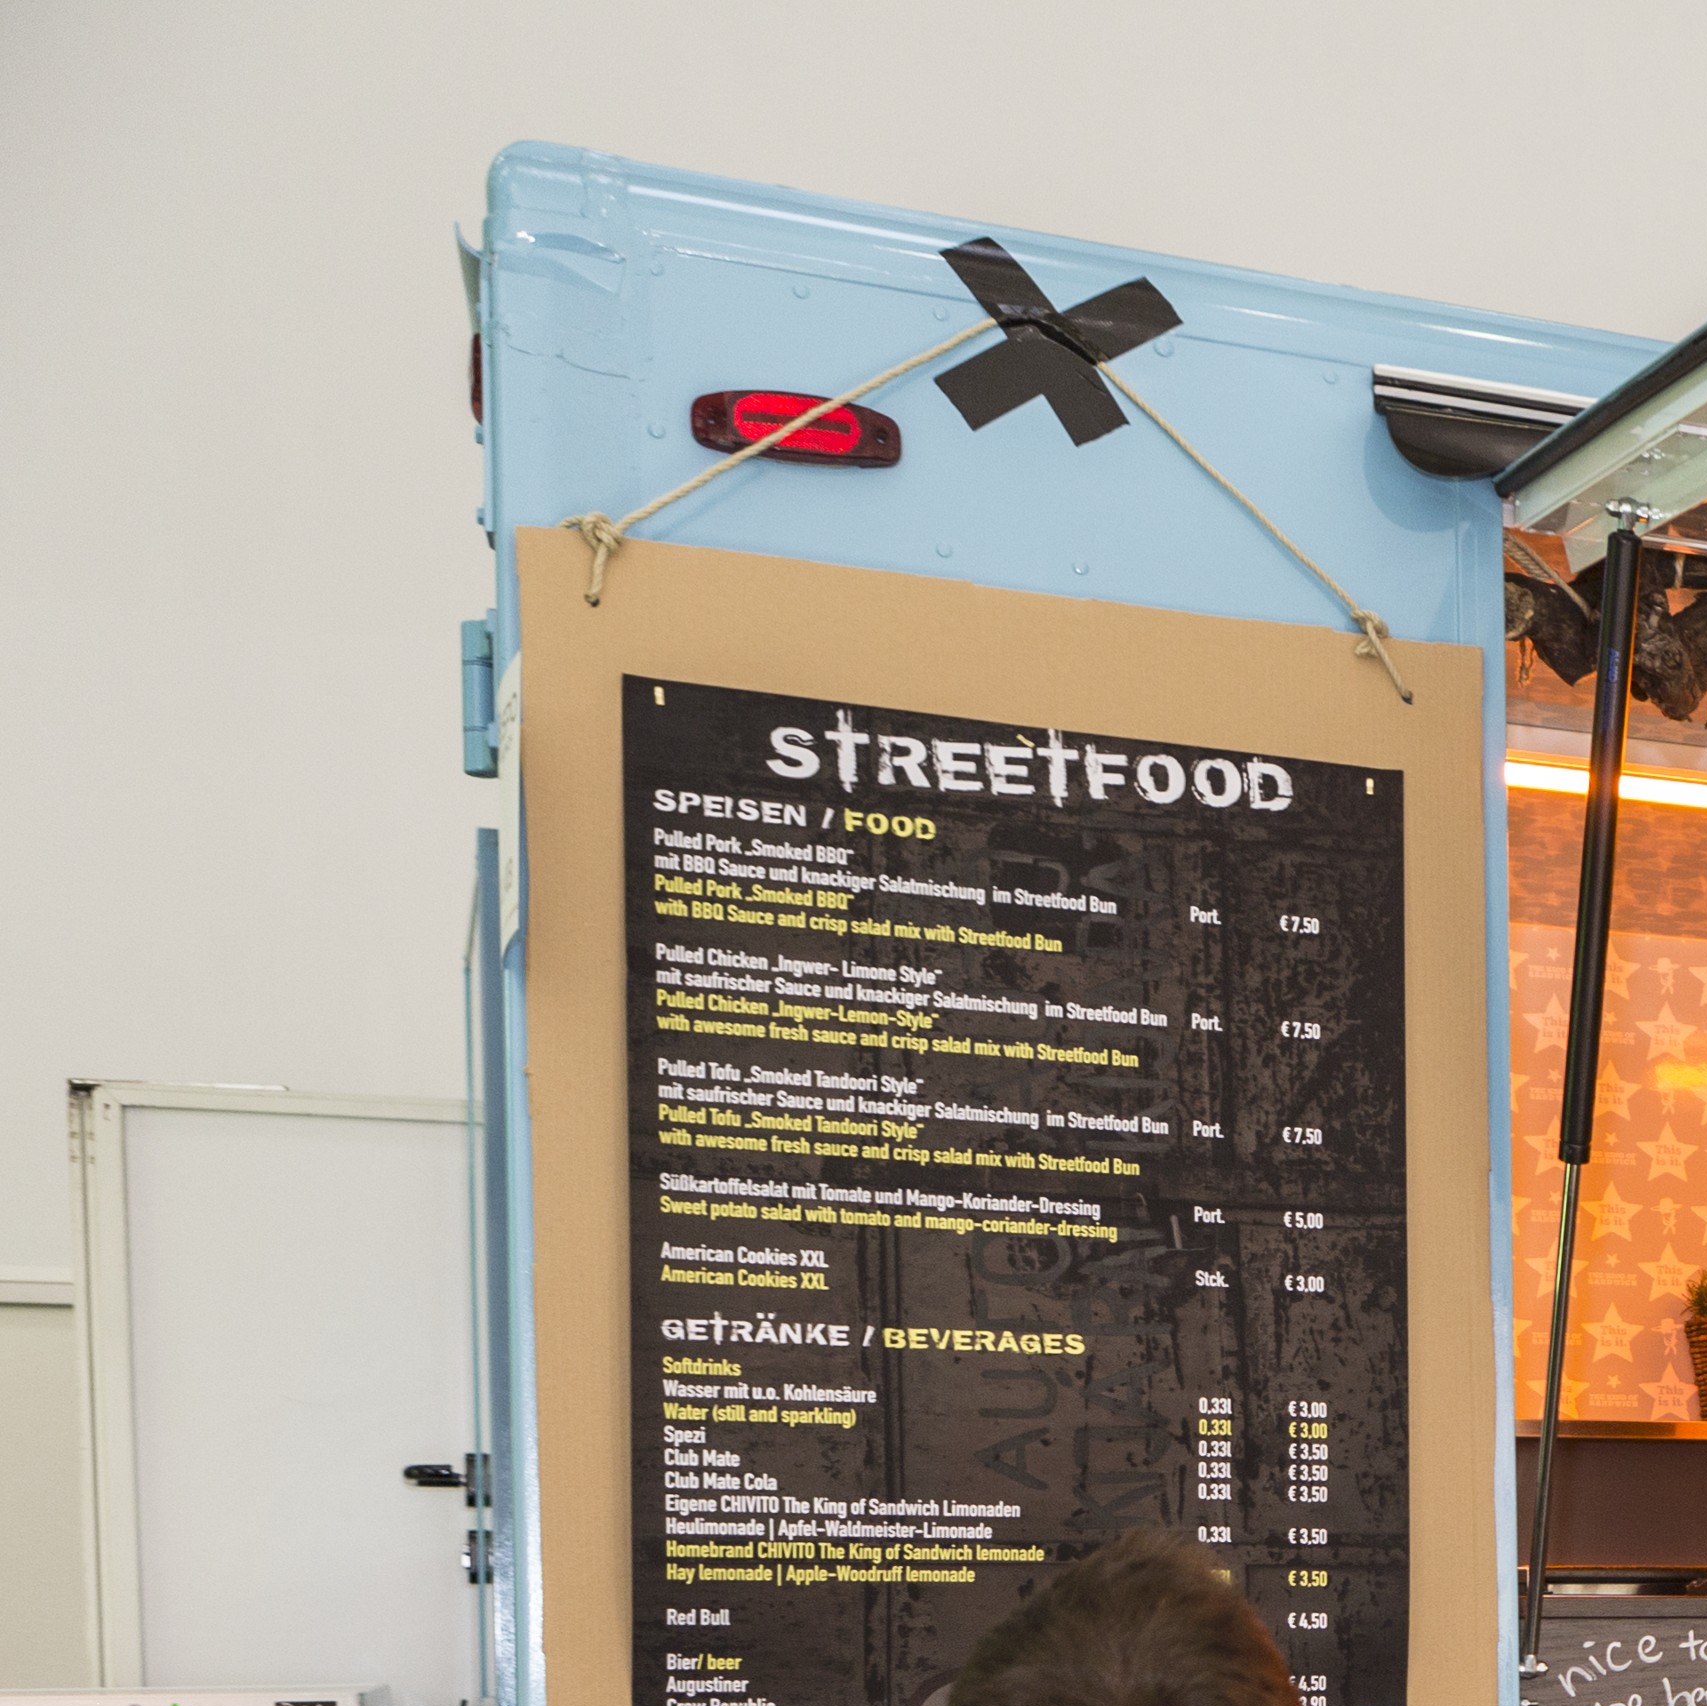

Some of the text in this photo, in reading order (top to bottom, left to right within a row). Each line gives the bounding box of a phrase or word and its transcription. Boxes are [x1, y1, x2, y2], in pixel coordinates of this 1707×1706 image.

[766, 709, 1295, 812] STREETFOOD
[653, 789, 808, 828] SPEISEN
[844, 808, 937, 841] FOOD
[654, 852, 1118, 916] mit BBQ Sauce und knackiger Salatmischung im Streetfood Bun
[1190, 906, 1223, 927] Port.
[660, 1172, 1102, 1222] Süßkartoffelsalat mit Tomate und Mango-Koriander-Dressing
[660, 1195, 1119, 1244] Sweet potato salad with tomato and mango-coriander-dressing
[660, 1241, 831, 1269] American Cookies XXL
[661, 1264, 831, 1291] American Cookies XXL
[660, 1311, 851, 1348] GETRÄNKE
[882, 1328, 1087, 1356] BEVERAGES
[662, 1356, 743, 1378] Softdrinks
[663, 1379, 722, 1400] Wasser
[723, 1382, 751, 1400] mit
[783, 1383, 878, 1404] Kohlensäure
[663, 1402, 857, 1430] Water (still and sparkling)
[664, 1425, 707, 1448] Spezi
[664, 1448, 742, 1468] Club Mate
[665, 1471, 779, 1492] Club Mate Cola
[665, 1494, 1022, 1520] Eigene CHIVITO The King of Sandwich Limonaden
[665, 1514, 766, 1537] Heulimonade
[778, 1517, 994, 1542] Apfel-Waldmeister-Limonade
[666, 1563, 697, 1586] Hay
[699, 1564, 774, 1582] lemonade
[785, 1565, 904, 1587] Apple-Woodruff
[906, 1566, 977, 1584] lemonade
[666, 1608, 732, 1627] Red Bull
[707, 1654, 743, 1671] beer
[1557, 1635, 1664, 1698] nice
[666, 1676, 750, 1698] Augustiner
